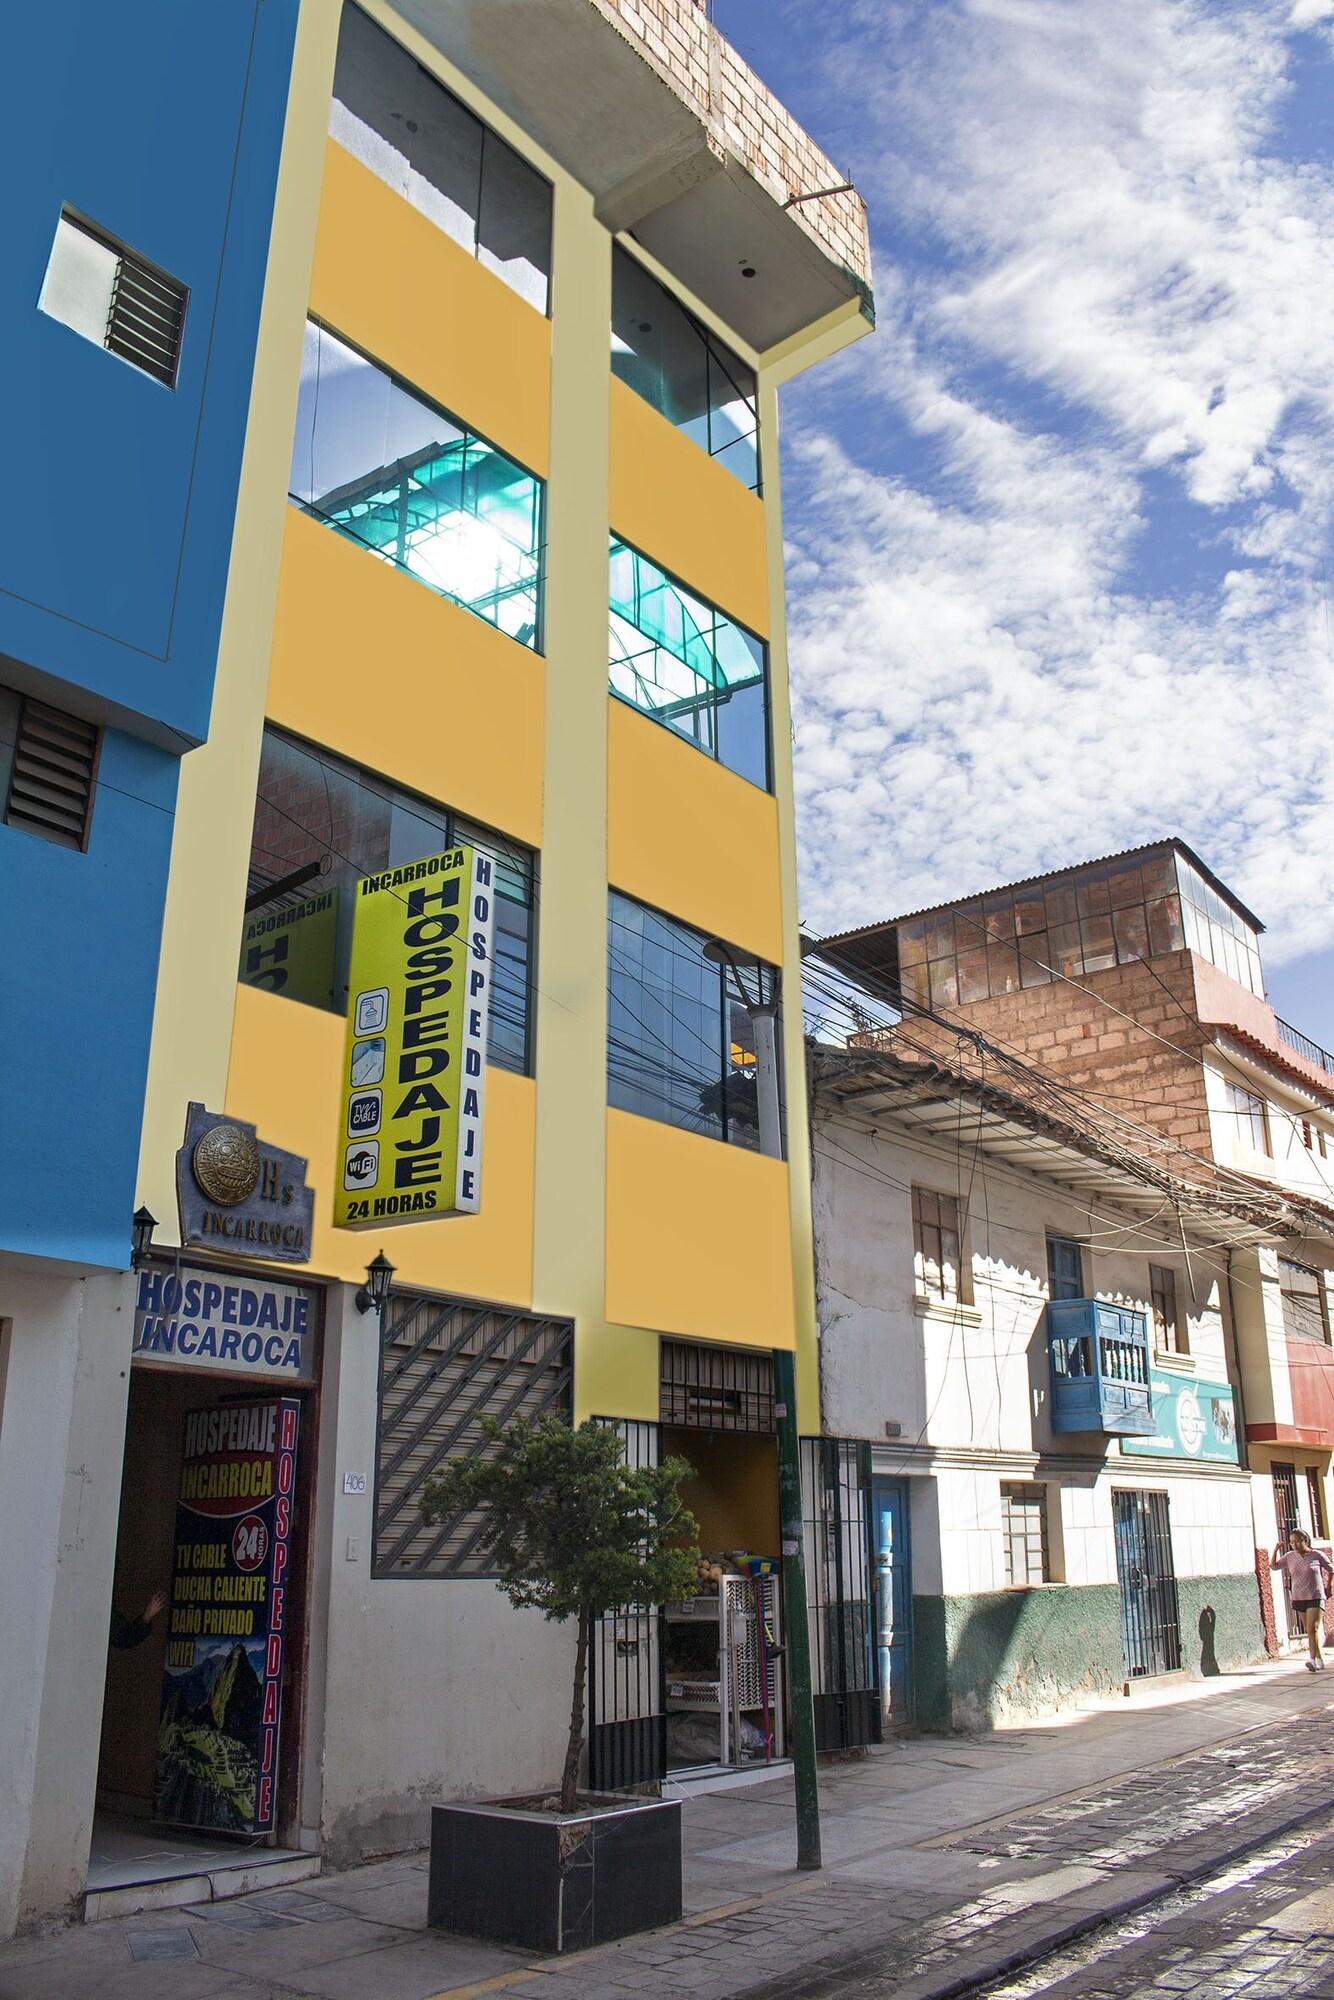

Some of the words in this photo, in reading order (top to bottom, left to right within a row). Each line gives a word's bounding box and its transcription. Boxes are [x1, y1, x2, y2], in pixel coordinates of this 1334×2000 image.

[362, 850, 464, 895] INCARROCA
[391, 877, 461, 1188] HOSPEDAJE
[462, 857, 492, 1199] HOSPEDAJE
[353, 1110, 377, 1124] CABLE
[347, 1201, 370, 1220] 24
[374, 1190, 437, 1216] HORAS
[202, 1210, 305, 1248] INCARROCA
[138, 1270, 309, 1334] HOSPEDAJE
[140, 1316, 300, 1368] INCAROCA
[185, 1405, 277, 1458] HOSPEDAJE
[181, 1460, 272, 1499] INCARROCA
[346, 1473, 365, 1490] 406
[177, 1544, 191, 1569] TV
[192, 1543, 227, 1569] CABLE
[236, 1526, 259, 1561] 24
[174, 1576, 212, 1601] DUCHA
[213, 1576, 266, 1601] CALIENTE
[171, 1605, 201, 1634] BAÑO
[203, 1609, 254, 1635] PRIVADO
[259, 1409, 297, 1822] HOSPEDAJE
[168, 1640, 195, 1667] WIFI
